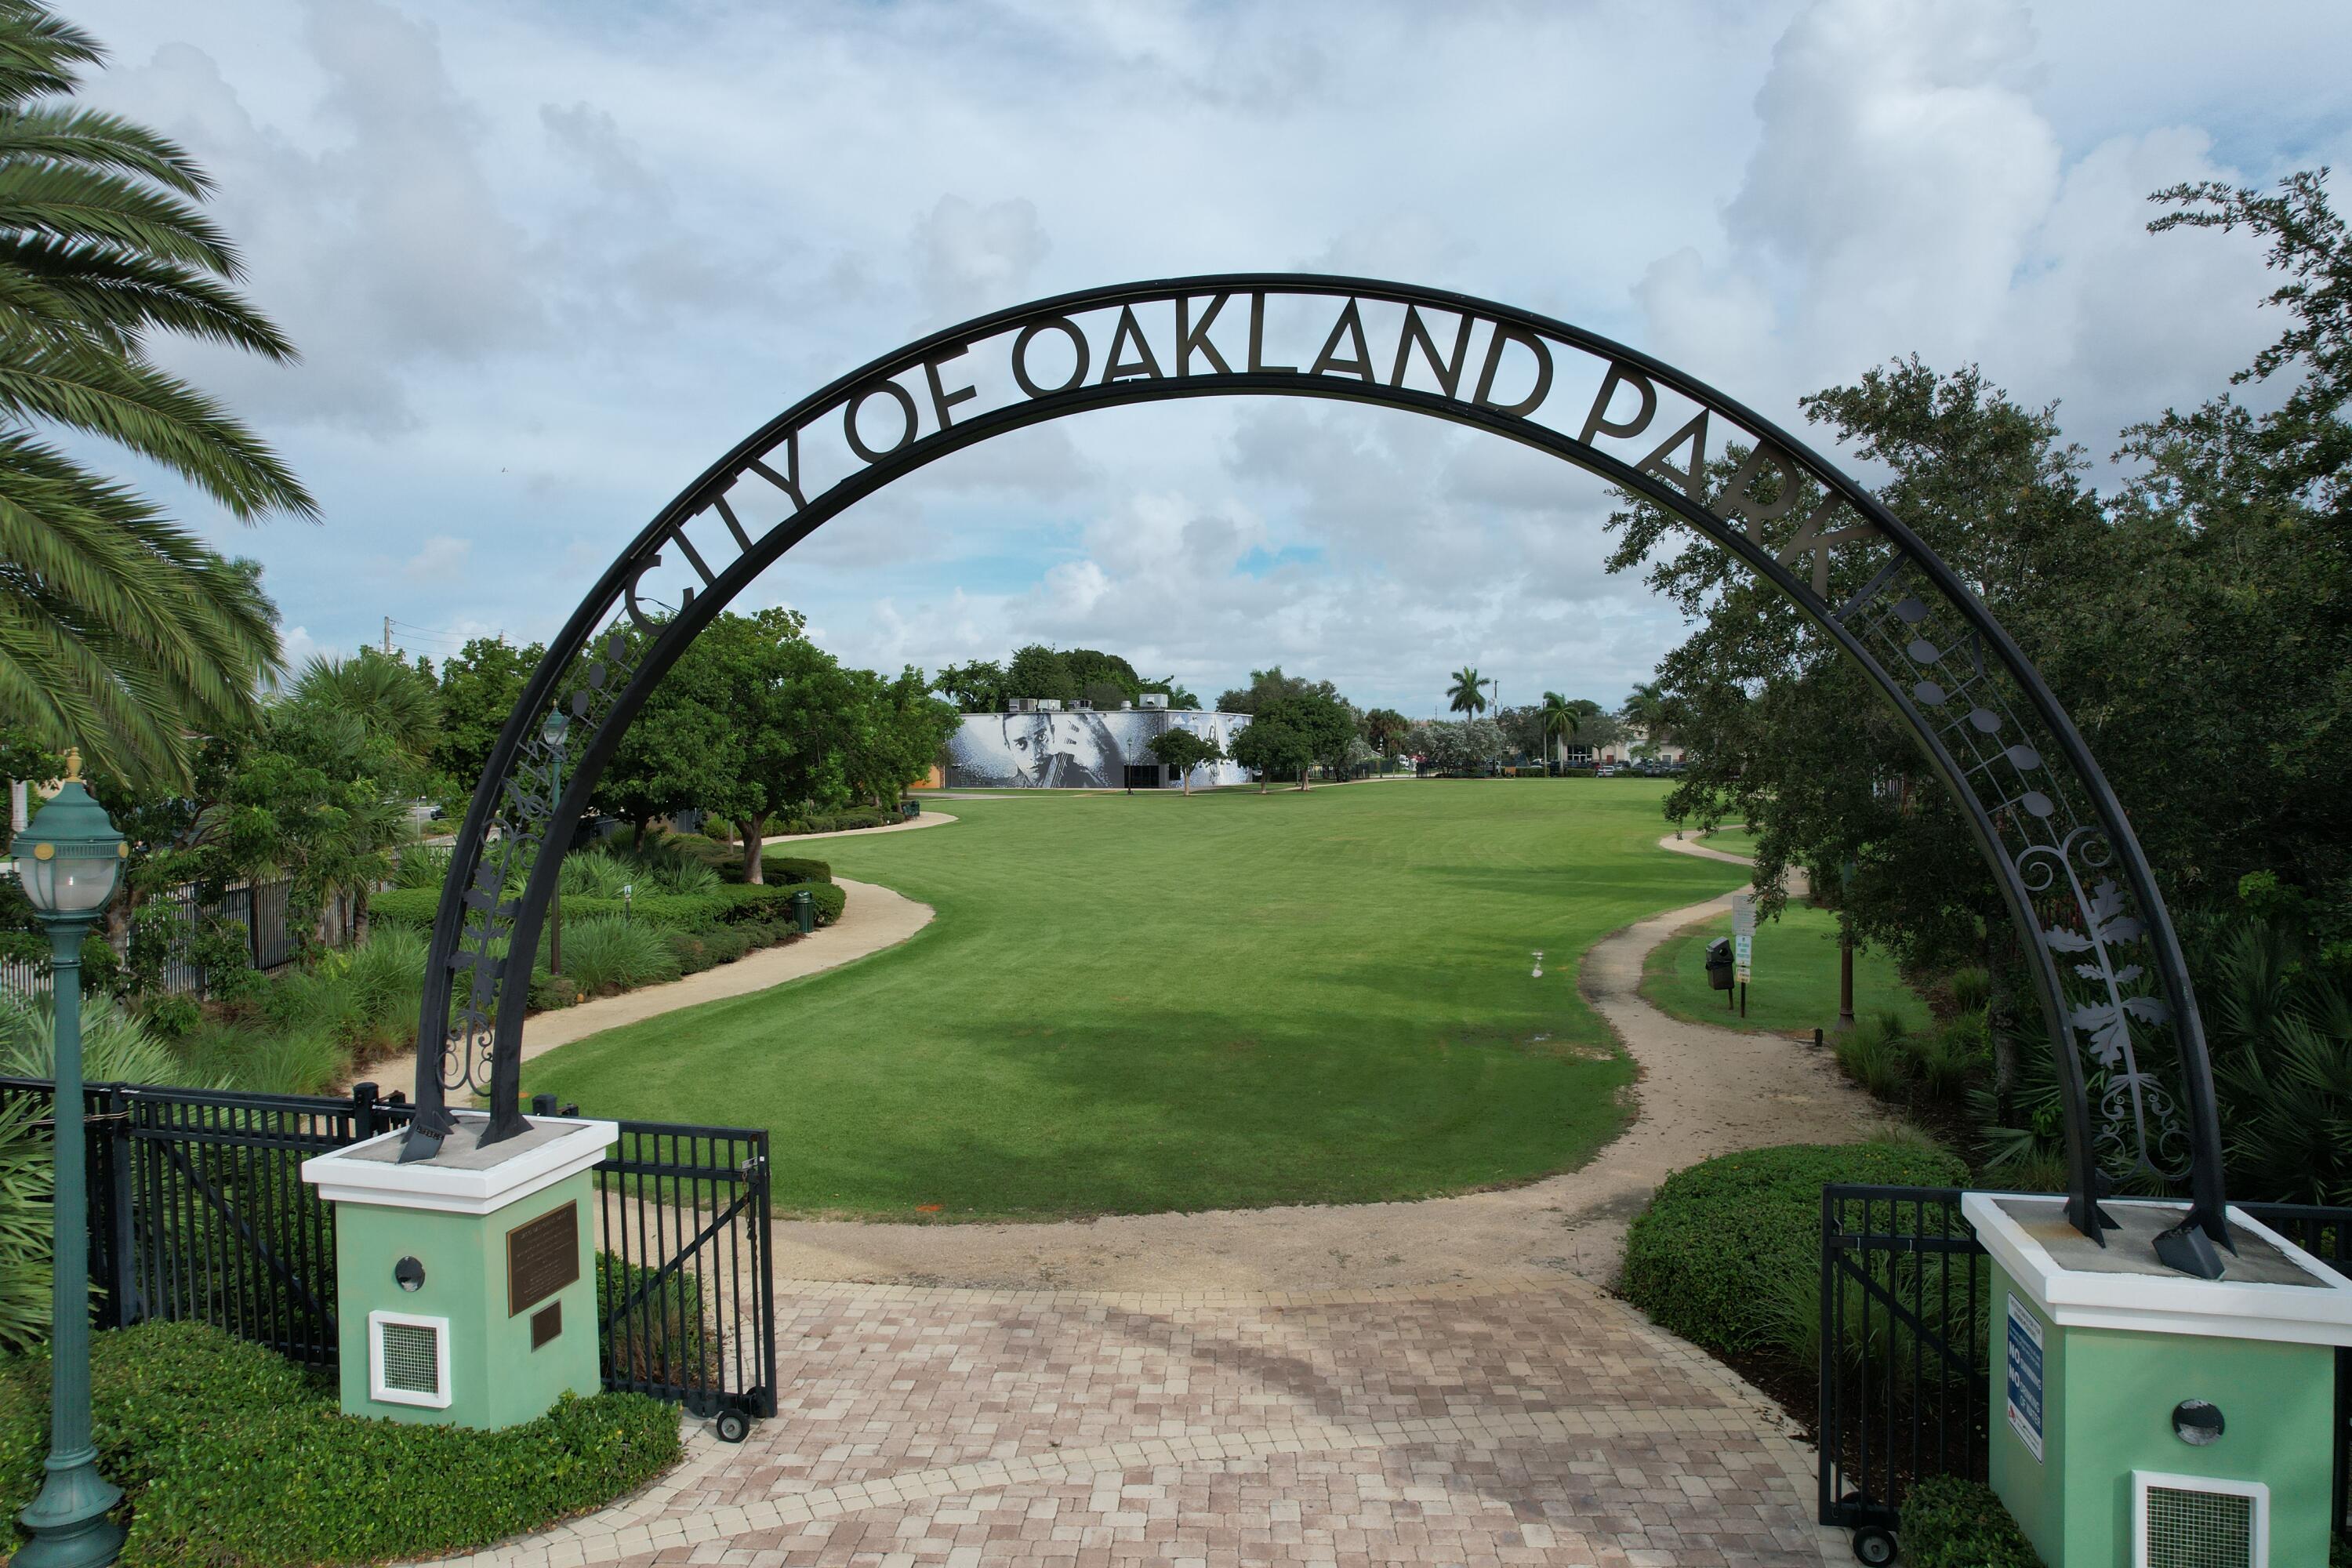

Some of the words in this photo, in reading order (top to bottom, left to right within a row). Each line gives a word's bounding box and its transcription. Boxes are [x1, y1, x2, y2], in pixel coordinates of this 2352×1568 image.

[625, 425, 808, 637] CITY
[844, 342, 978, 464] OF
[1011, 292, 1553, 419] OAKLAND
[1578, 359, 1882, 604] PARK
[2009, 1341, 2020, 1364] NO
[2009, 1363, 2020, 1388] NO
